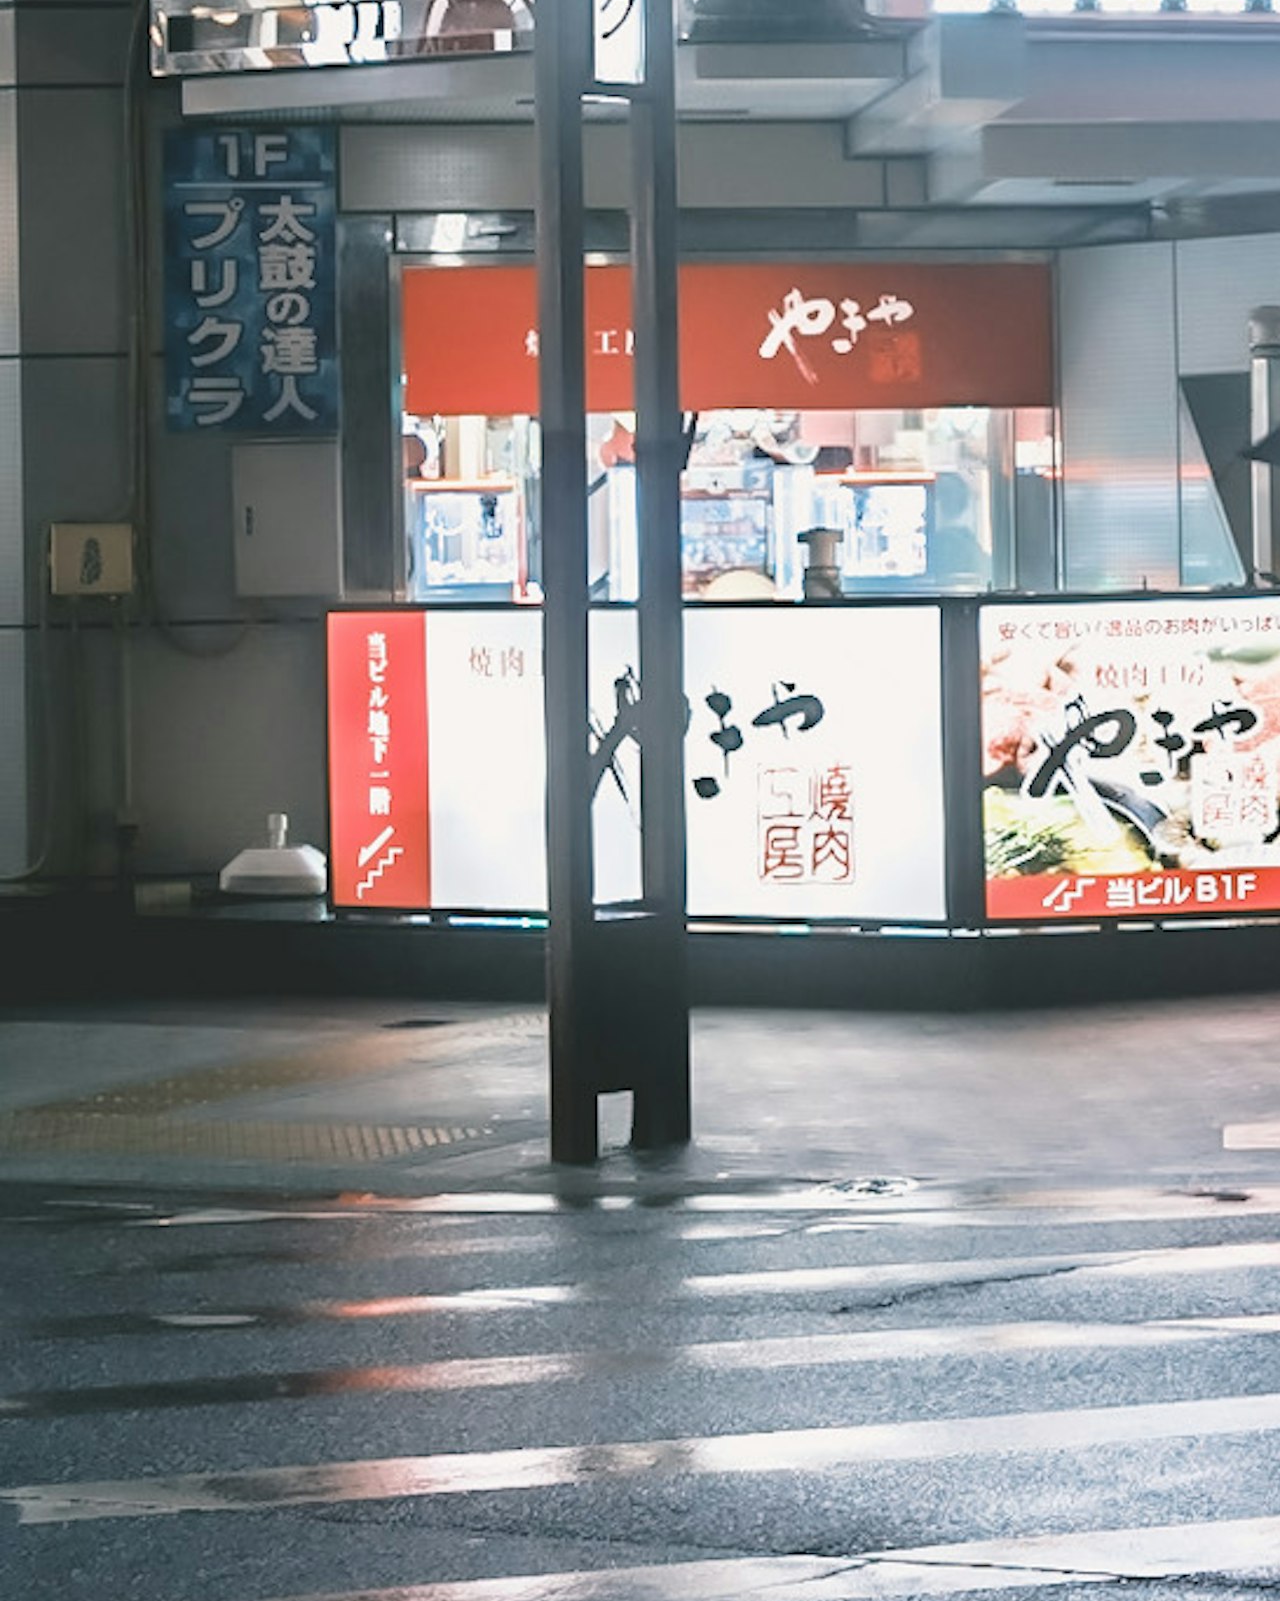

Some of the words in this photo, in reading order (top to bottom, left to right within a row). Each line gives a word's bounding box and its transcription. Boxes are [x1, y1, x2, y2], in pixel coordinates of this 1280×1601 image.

[218, 135, 288, 178] 1F
[184, 197, 245, 426] プリクラ
[257, 195, 319, 422] 太鼓の達人
